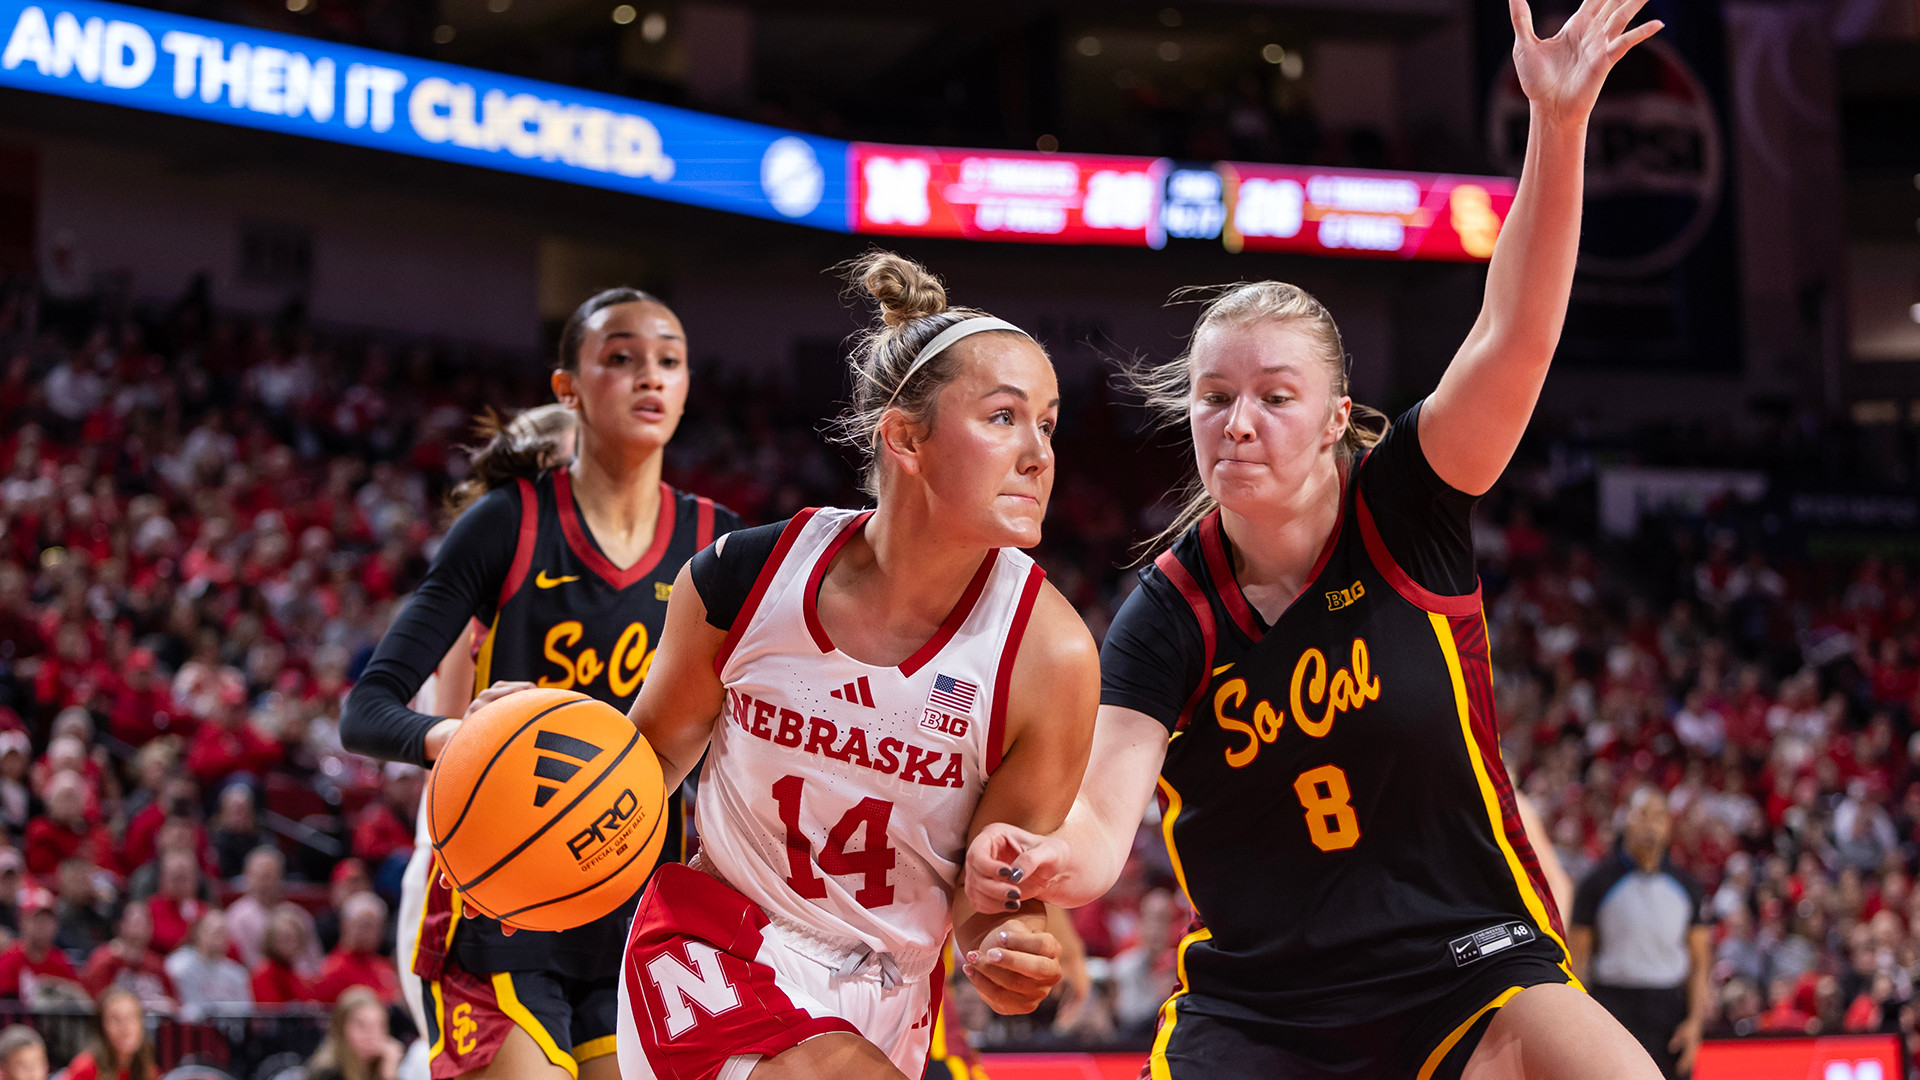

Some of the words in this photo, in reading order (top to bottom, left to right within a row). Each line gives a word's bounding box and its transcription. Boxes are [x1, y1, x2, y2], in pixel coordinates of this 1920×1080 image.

[1, 6, 156, 89] AND
[162, 31, 335, 122] THEN
[345, 63, 406, 133] IT
[537, 620, 604, 690] So
[730, 687, 965, 788] NEBRASKA
[1213, 676, 1285, 768] So
[1290, 637, 1381, 738] Cal
[566, 789, 637, 860] PRO
[581, 847, 613, 872] OFFICIAL
[614, 828, 633, 847] GAME
[772, 774, 895, 909] 14
[1293, 763, 1362, 852] 8
[1458, 950, 1477, 960] TEAM
[1513, 925, 1529, 936] 48
[646, 941, 742, 1041] N
